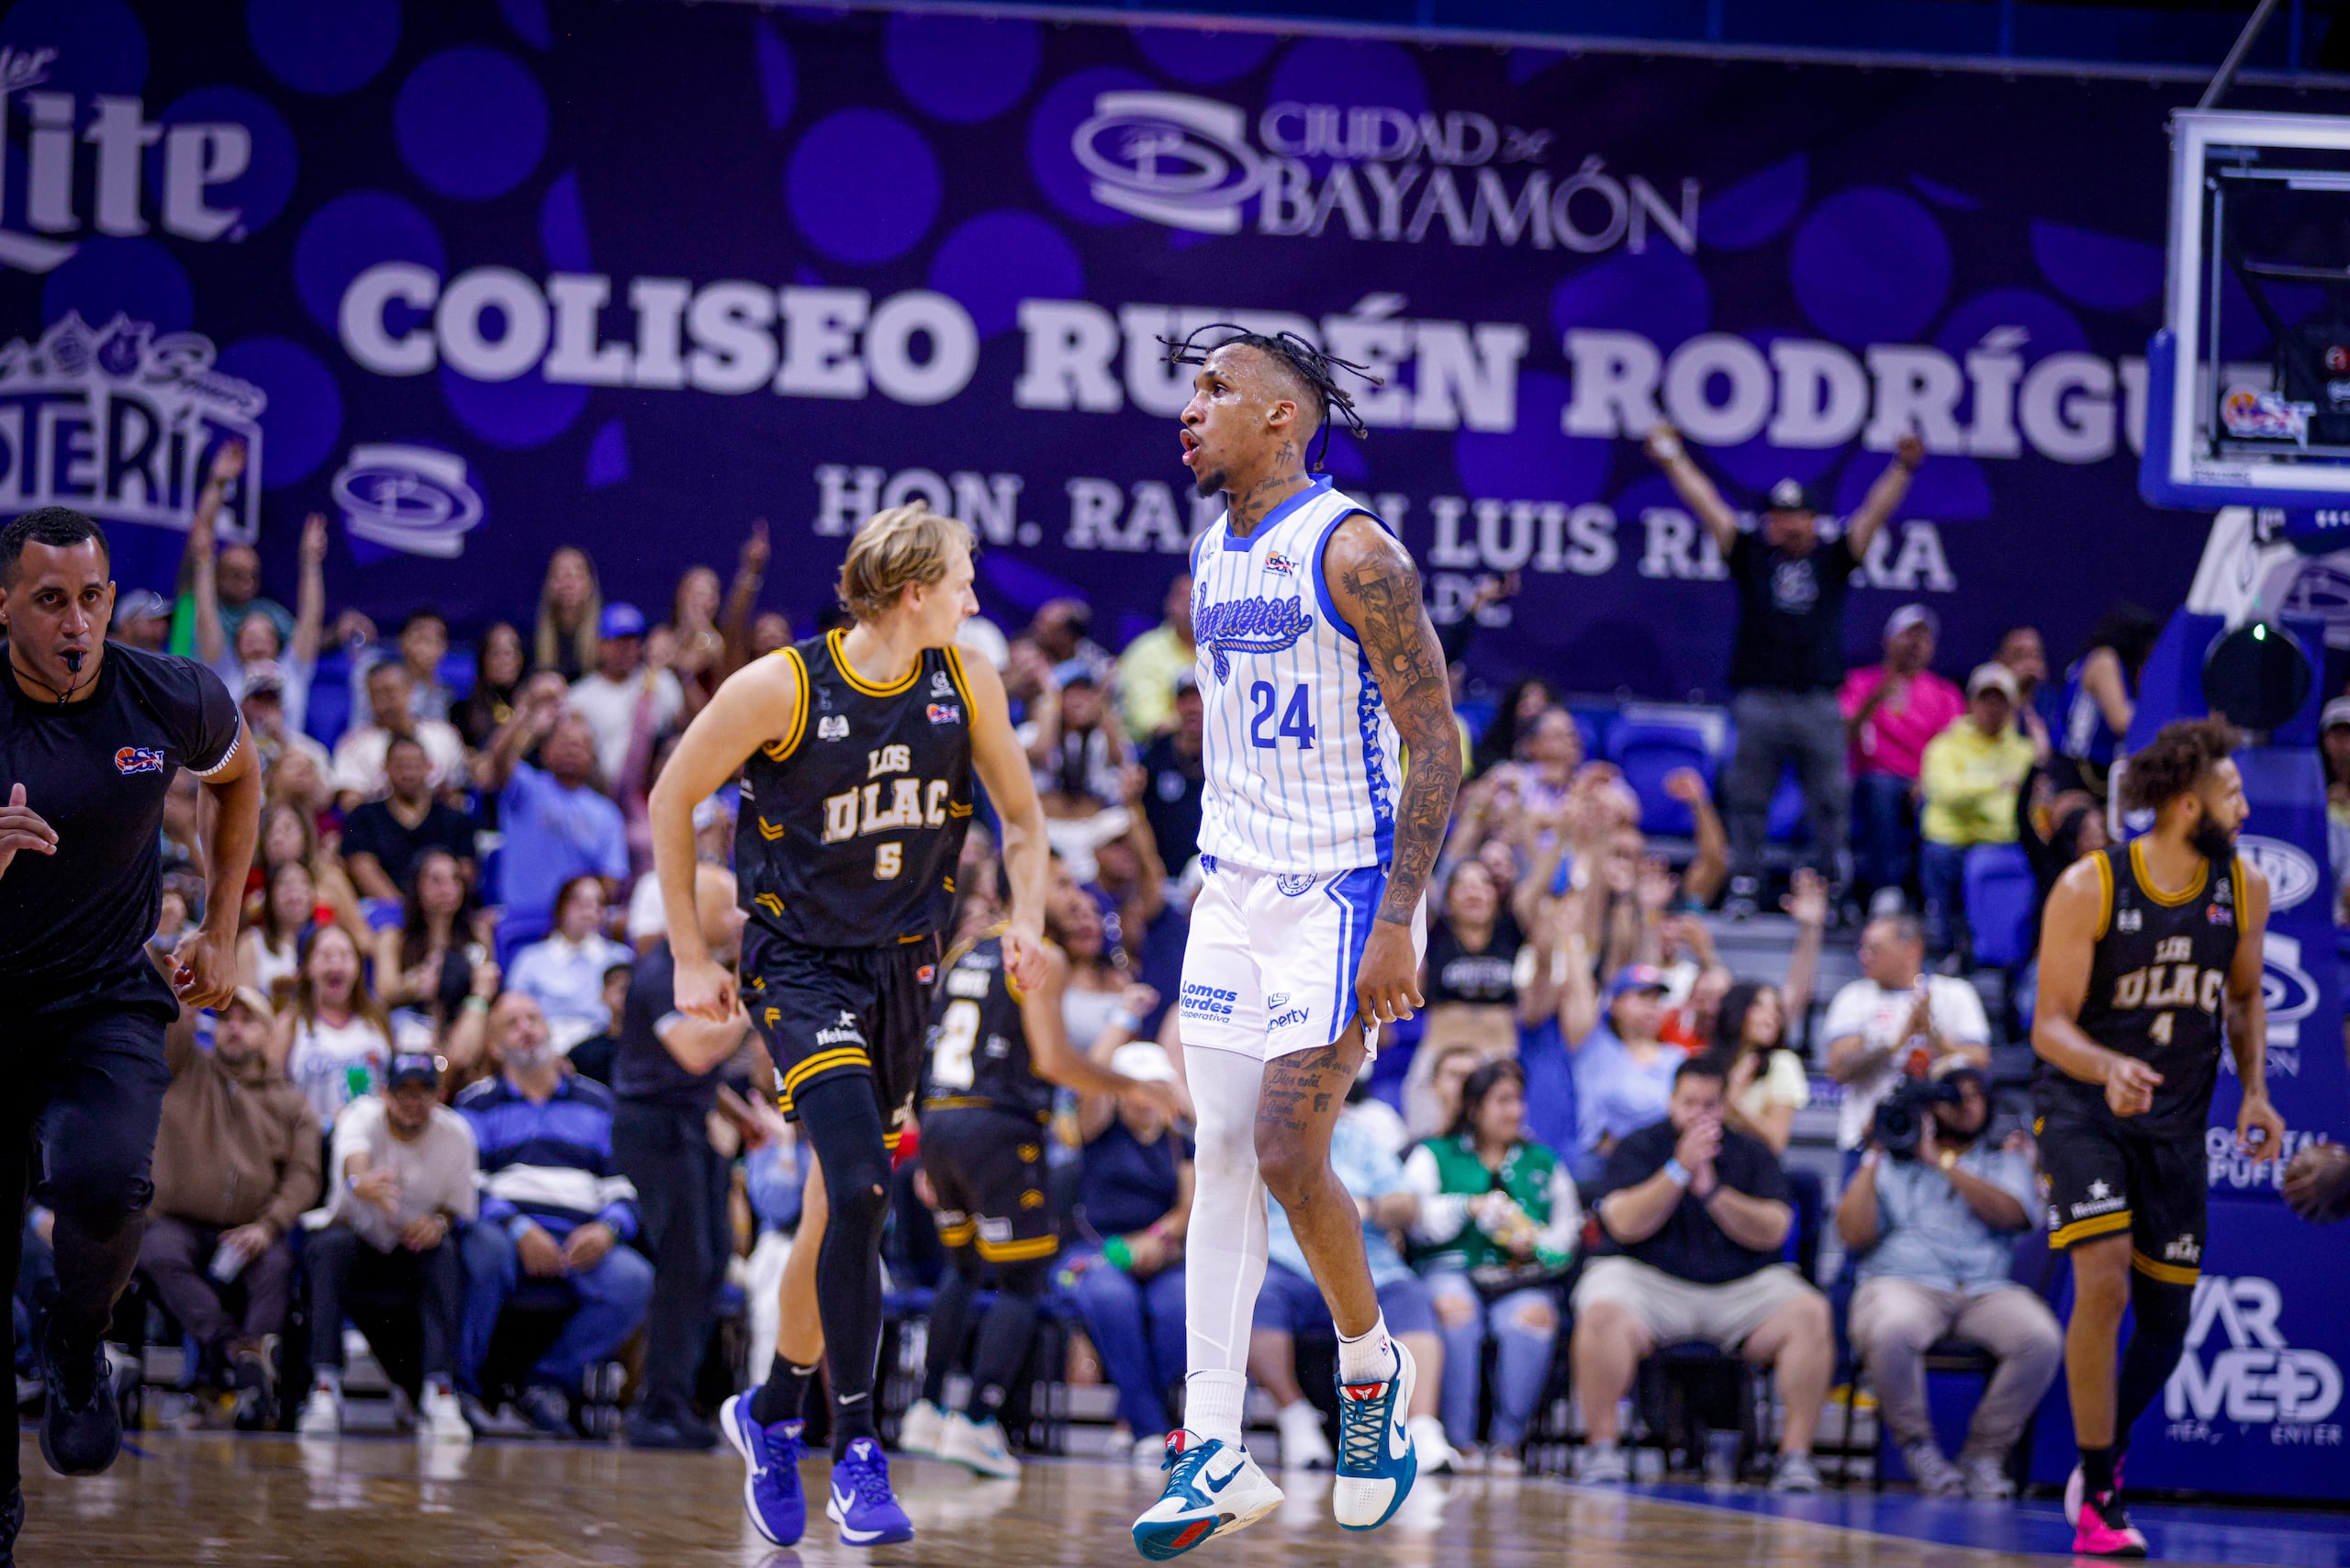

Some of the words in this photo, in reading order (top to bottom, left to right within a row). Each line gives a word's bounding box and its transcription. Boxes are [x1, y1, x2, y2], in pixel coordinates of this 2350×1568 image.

[1258, 100, 1499, 166] CIUDAD
[0, 92, 252, 274] ite
[1256, 152, 1701, 254] BAYAMÓN
[337, 260, 980, 407] COLISEO
[1013, 291, 1529, 434] RUÉN
[811, 463, 1043, 549] HON.
[1426, 494, 1619, 577] LUIS
[1249, 680, 1315, 750] 24
[115, 746, 164, 775] BSN
[867, 743, 912, 779] LOS
[873, 841, 903, 881] 5
[2153, 935, 2193, 964] LOS
[1181, 980, 1237, 1002] Lomas
[1181, 993, 1234, 1014] Verdes
[2148, 1010, 2176, 1046] 4
